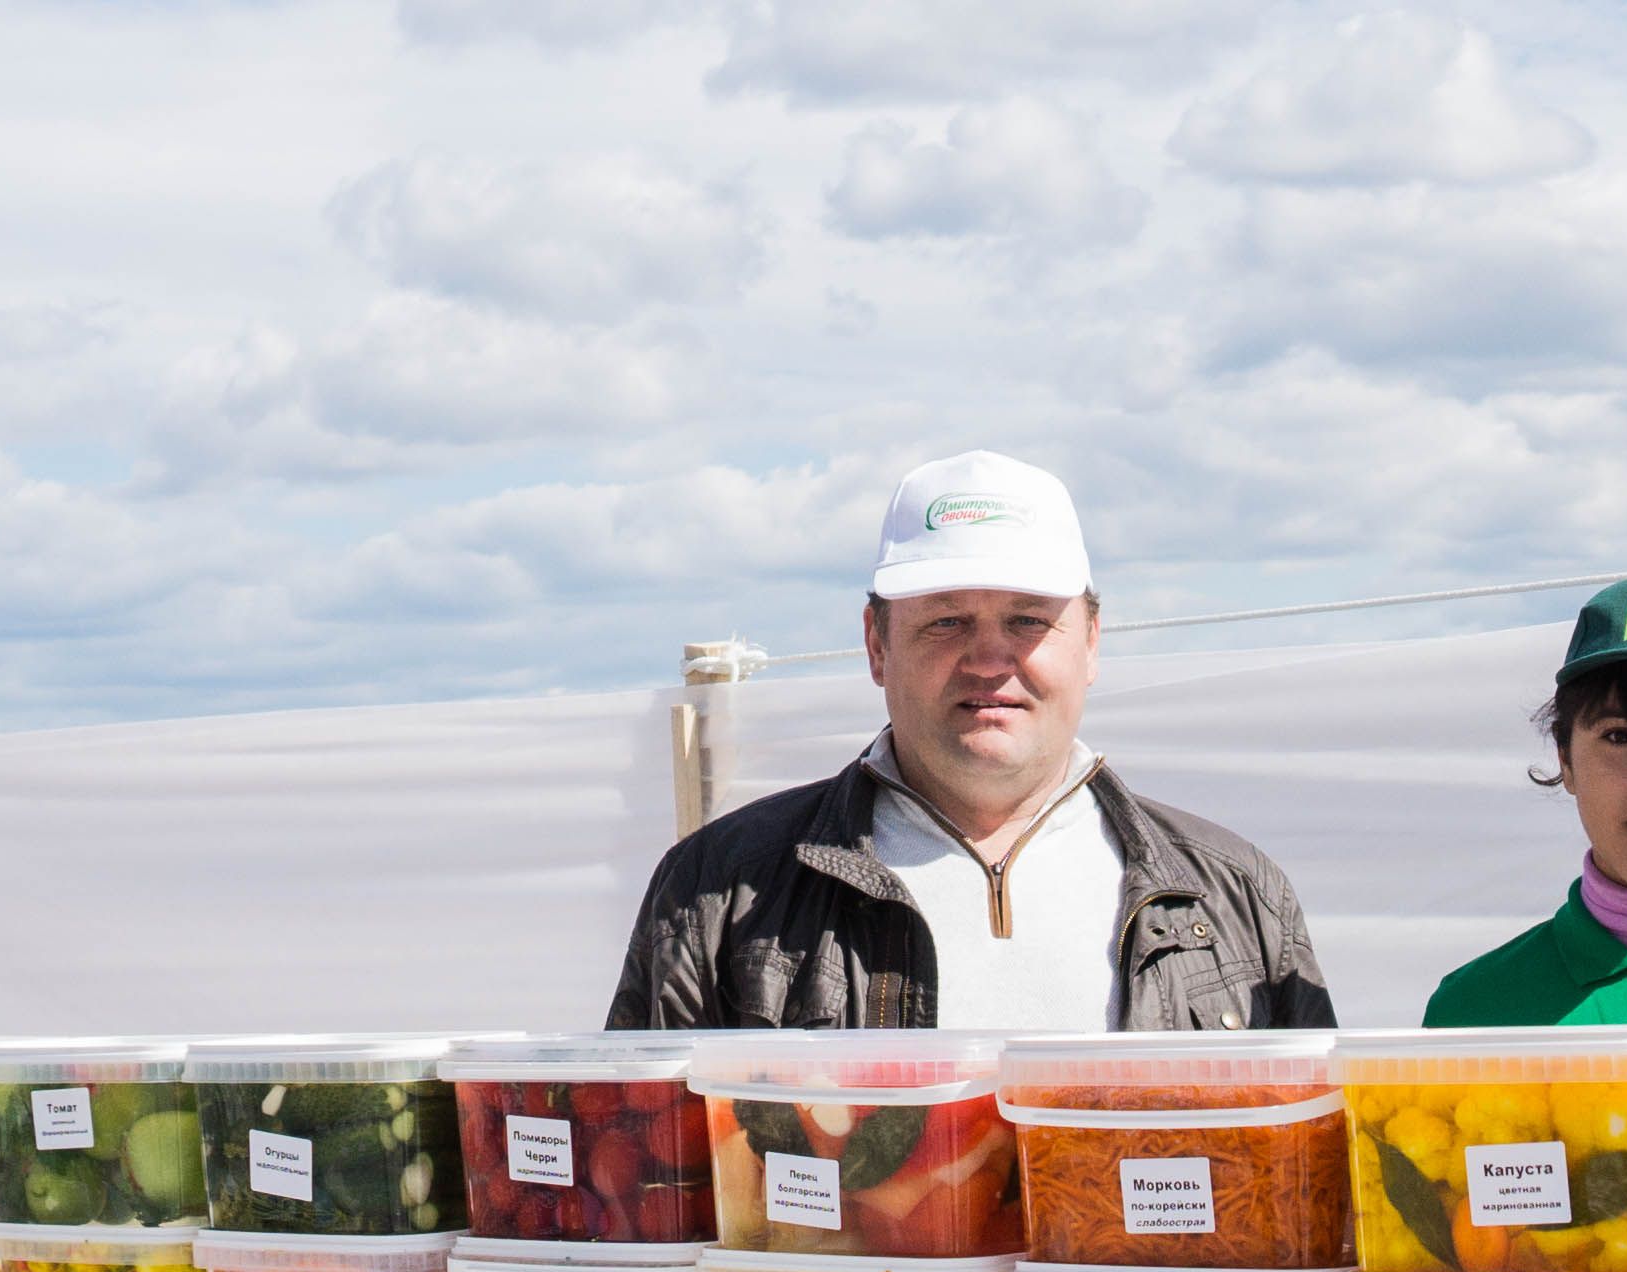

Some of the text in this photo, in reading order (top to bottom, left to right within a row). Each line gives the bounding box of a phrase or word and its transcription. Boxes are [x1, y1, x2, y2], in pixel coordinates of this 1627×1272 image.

[941, 511, 987, 522] овощи
[47, 1103, 77, 1113] Томат
[513, 1130, 570, 1146] Помидоры
[265, 1146, 300, 1162] Огурцы
[525, 1149, 558, 1164] Черри
[789, 1169, 818, 1184] Перец
[1483, 1163, 1555, 1181] Капуста
[777, 1183, 831, 1199] болгарский
[1133, 1178, 1201, 1196] Морковь
[1499, 1186, 1542, 1197] цветная
[1131, 1201, 1207, 1214] по-корейски
[1483, 1200, 1563, 1212] маринованная
[1135, 1218, 1206, 1229] слабоострая
